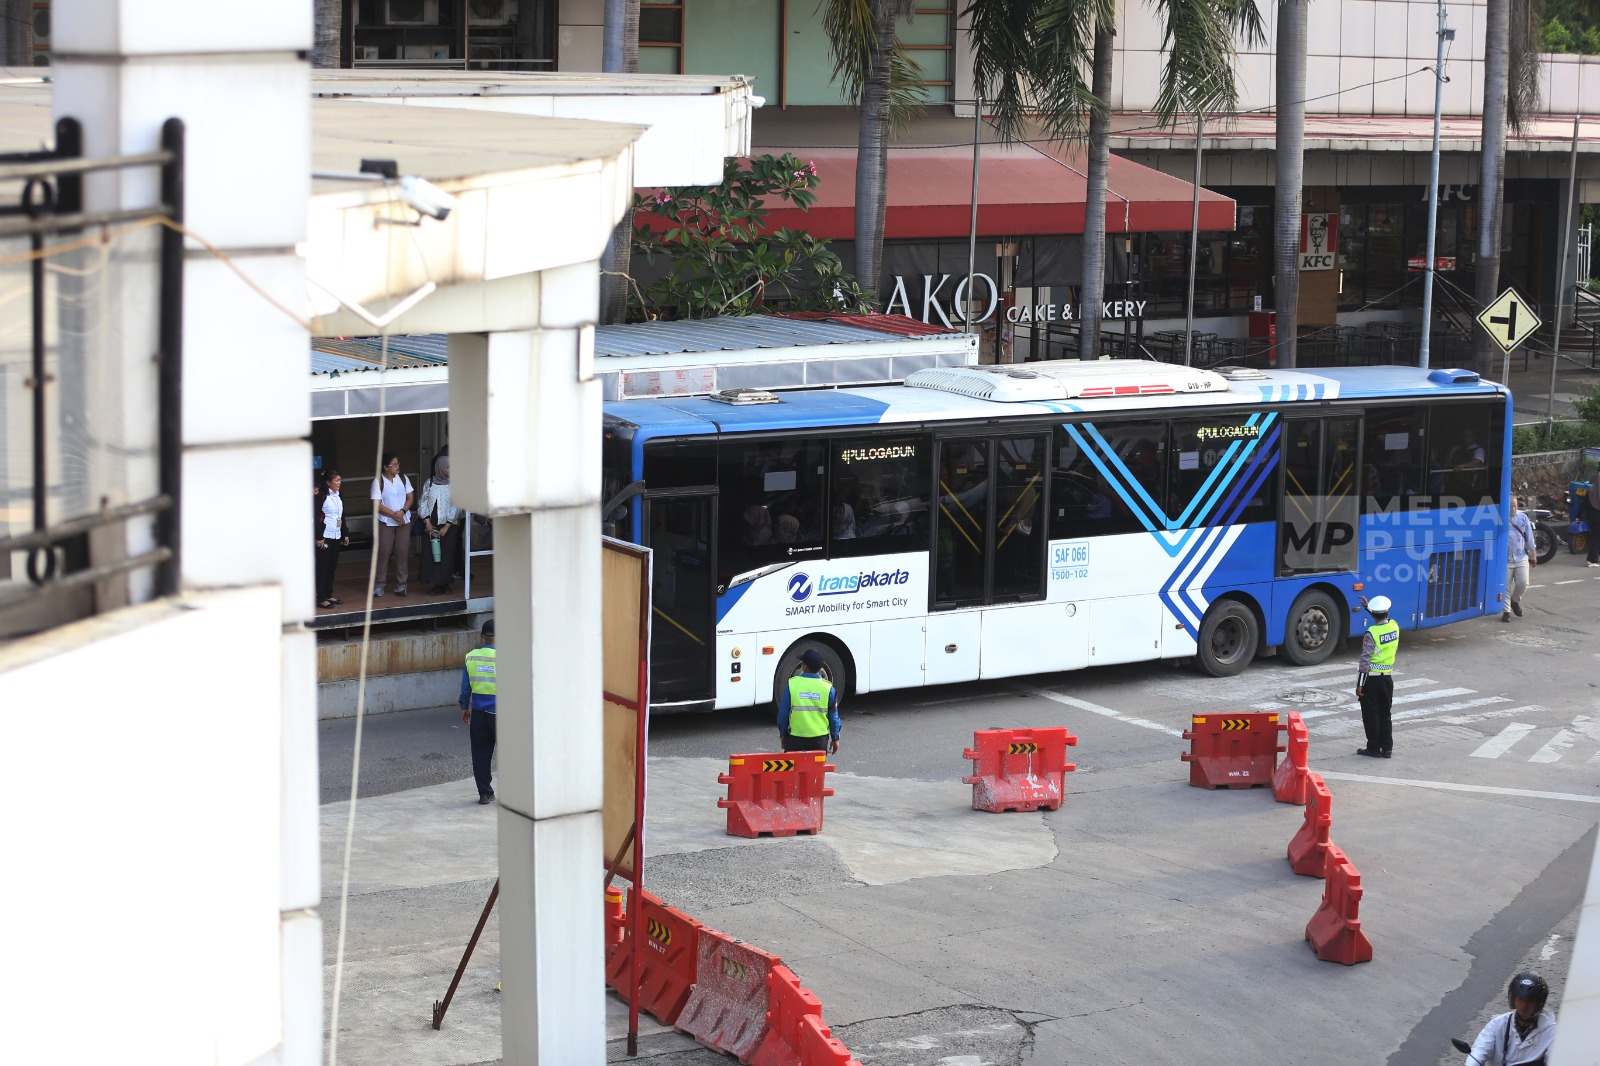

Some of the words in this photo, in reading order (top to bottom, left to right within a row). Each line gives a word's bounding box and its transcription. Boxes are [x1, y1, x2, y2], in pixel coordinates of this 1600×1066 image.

[1302, 255, 1332, 268] KFC
[1006, 303, 1056, 324] CAKE
[1061, 303, 1073, 320] &
[1078, 300, 1147, 319] KERY
[1055, 547, 1070, 563] SAF
[1071, 546, 1087, 562] 066
[816, 568, 910, 597] transjakarta
[1051, 569, 1089, 580] 1500-102
[785, 605, 816, 616] SMART
[817, 602, 851, 613] Mobility
[852, 601, 865, 610] for
[866, 599, 890, 609] Smart
[892, 597, 908, 607] City
[1380, 632, 1398, 643] POLIS
